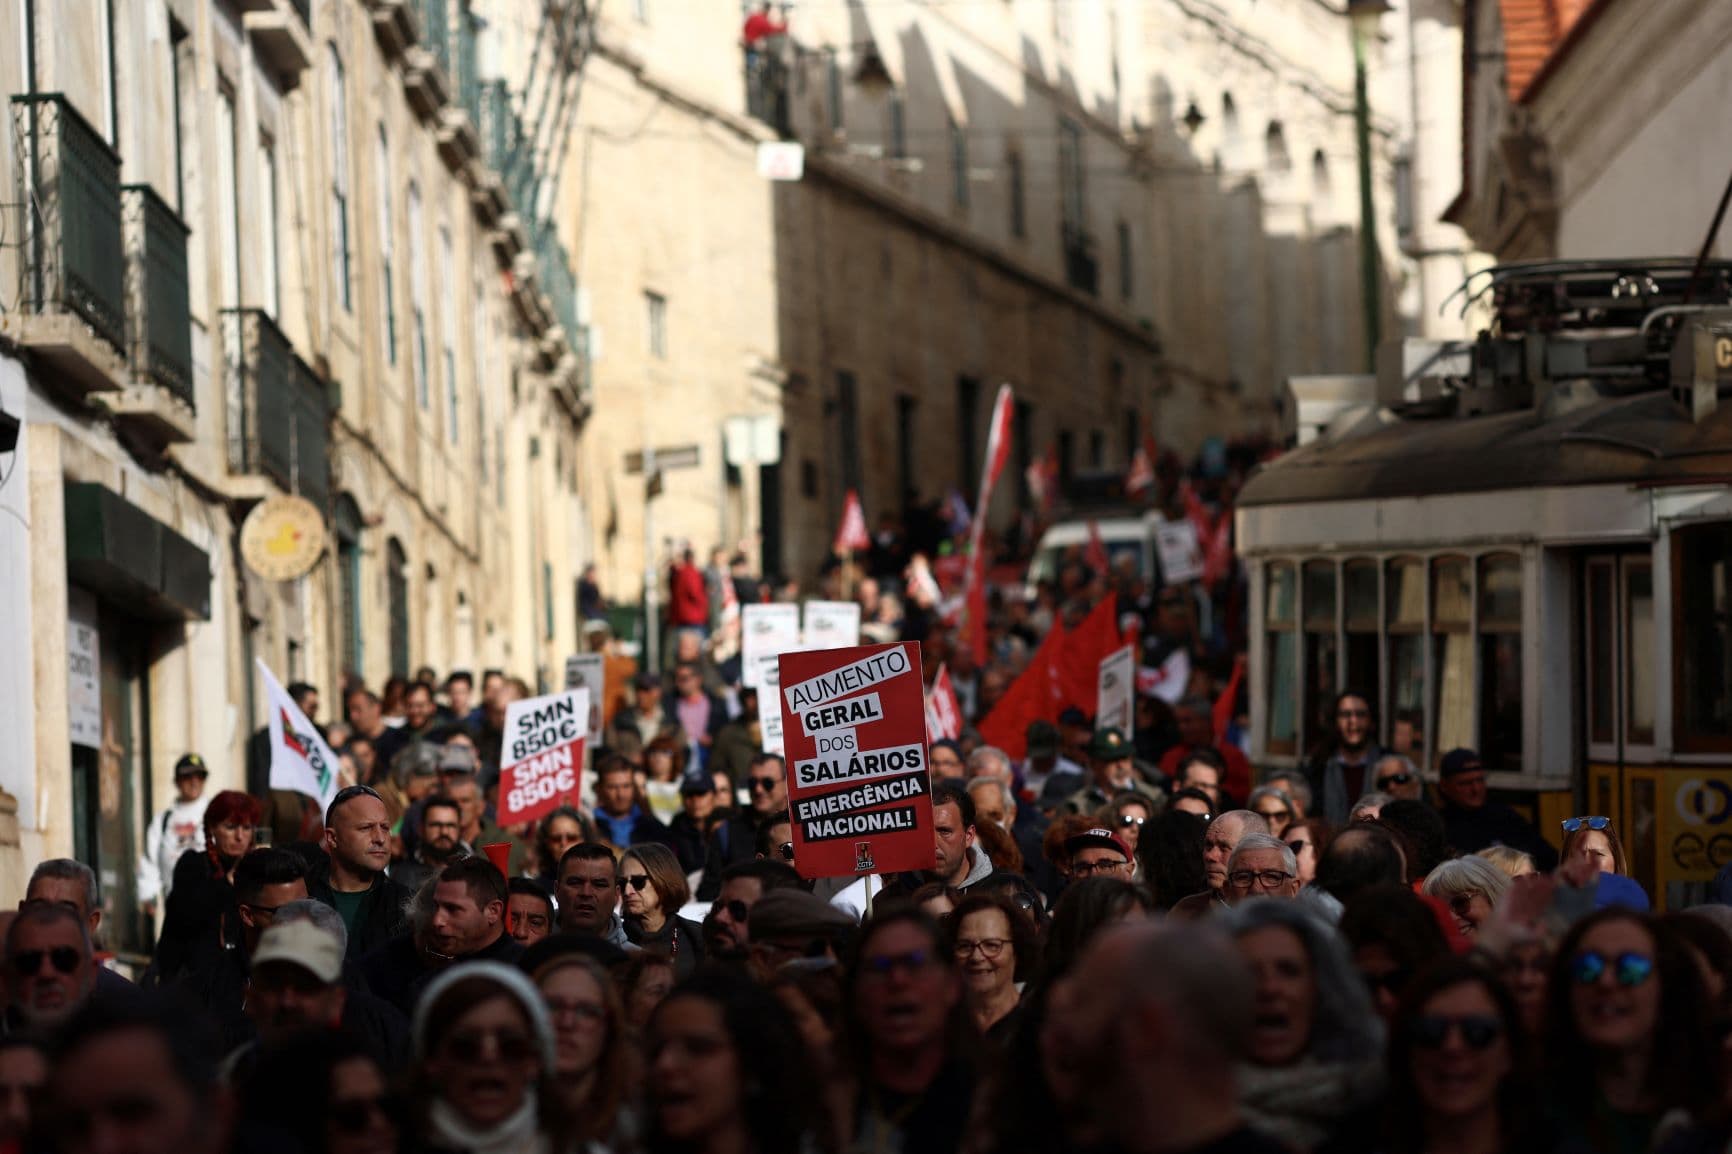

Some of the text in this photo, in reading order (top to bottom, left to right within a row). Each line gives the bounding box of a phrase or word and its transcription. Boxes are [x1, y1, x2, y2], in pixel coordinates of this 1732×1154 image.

[793, 652, 905, 710] AUMENTO
[518, 696, 574, 735] SMN
[805, 699, 878, 731] GERAL
[513, 719, 576, 760] 850€
[820, 735, 854, 753] DOS
[513, 745, 573, 786] SMN
[800, 750, 921, 784] SALÁRIOS
[507, 767, 575, 813] 850€
[799, 777, 922, 820] EMERGÊNCIA
[808, 810, 912, 839] NACIONAL!
